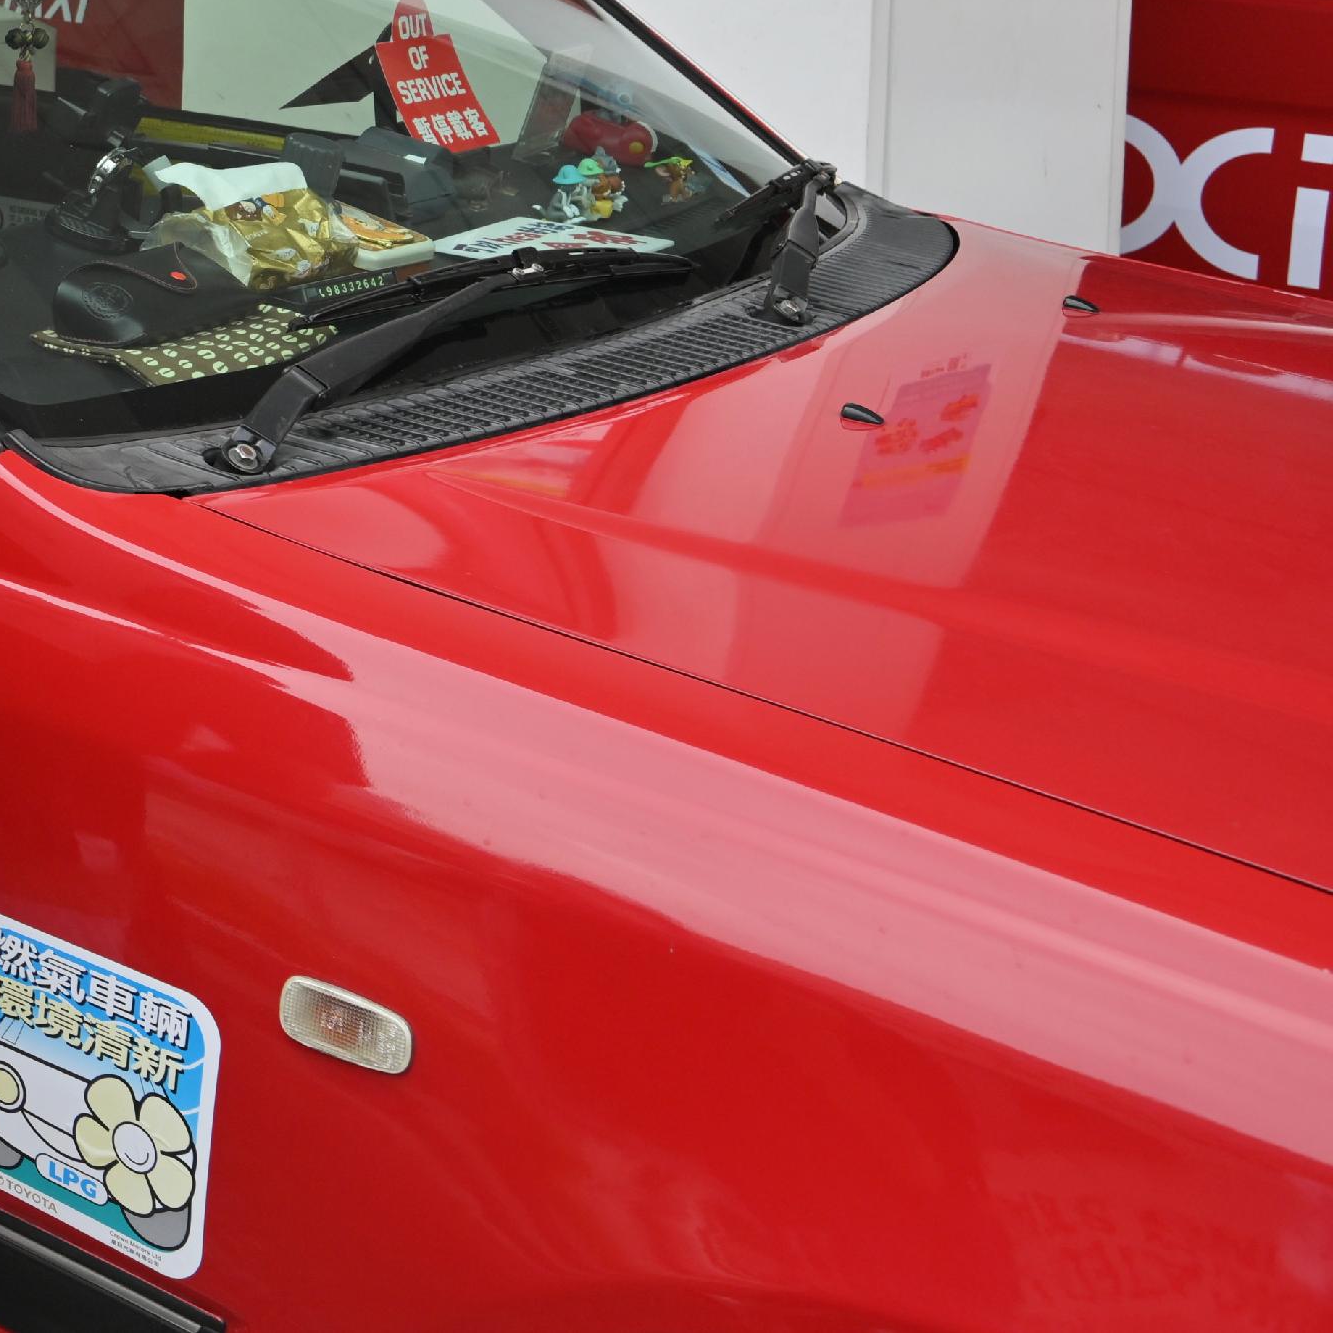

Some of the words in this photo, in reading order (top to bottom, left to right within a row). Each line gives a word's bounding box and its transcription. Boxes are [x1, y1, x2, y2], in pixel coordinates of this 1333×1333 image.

[398, 13, 428, 40] OUT
[408, 45, 429, 71] OF
[396, 72, 467, 104] SERVICE
[6, 1177, 59, 1214] TOYOTA
[49, 1161, 97, 1199] LPG
